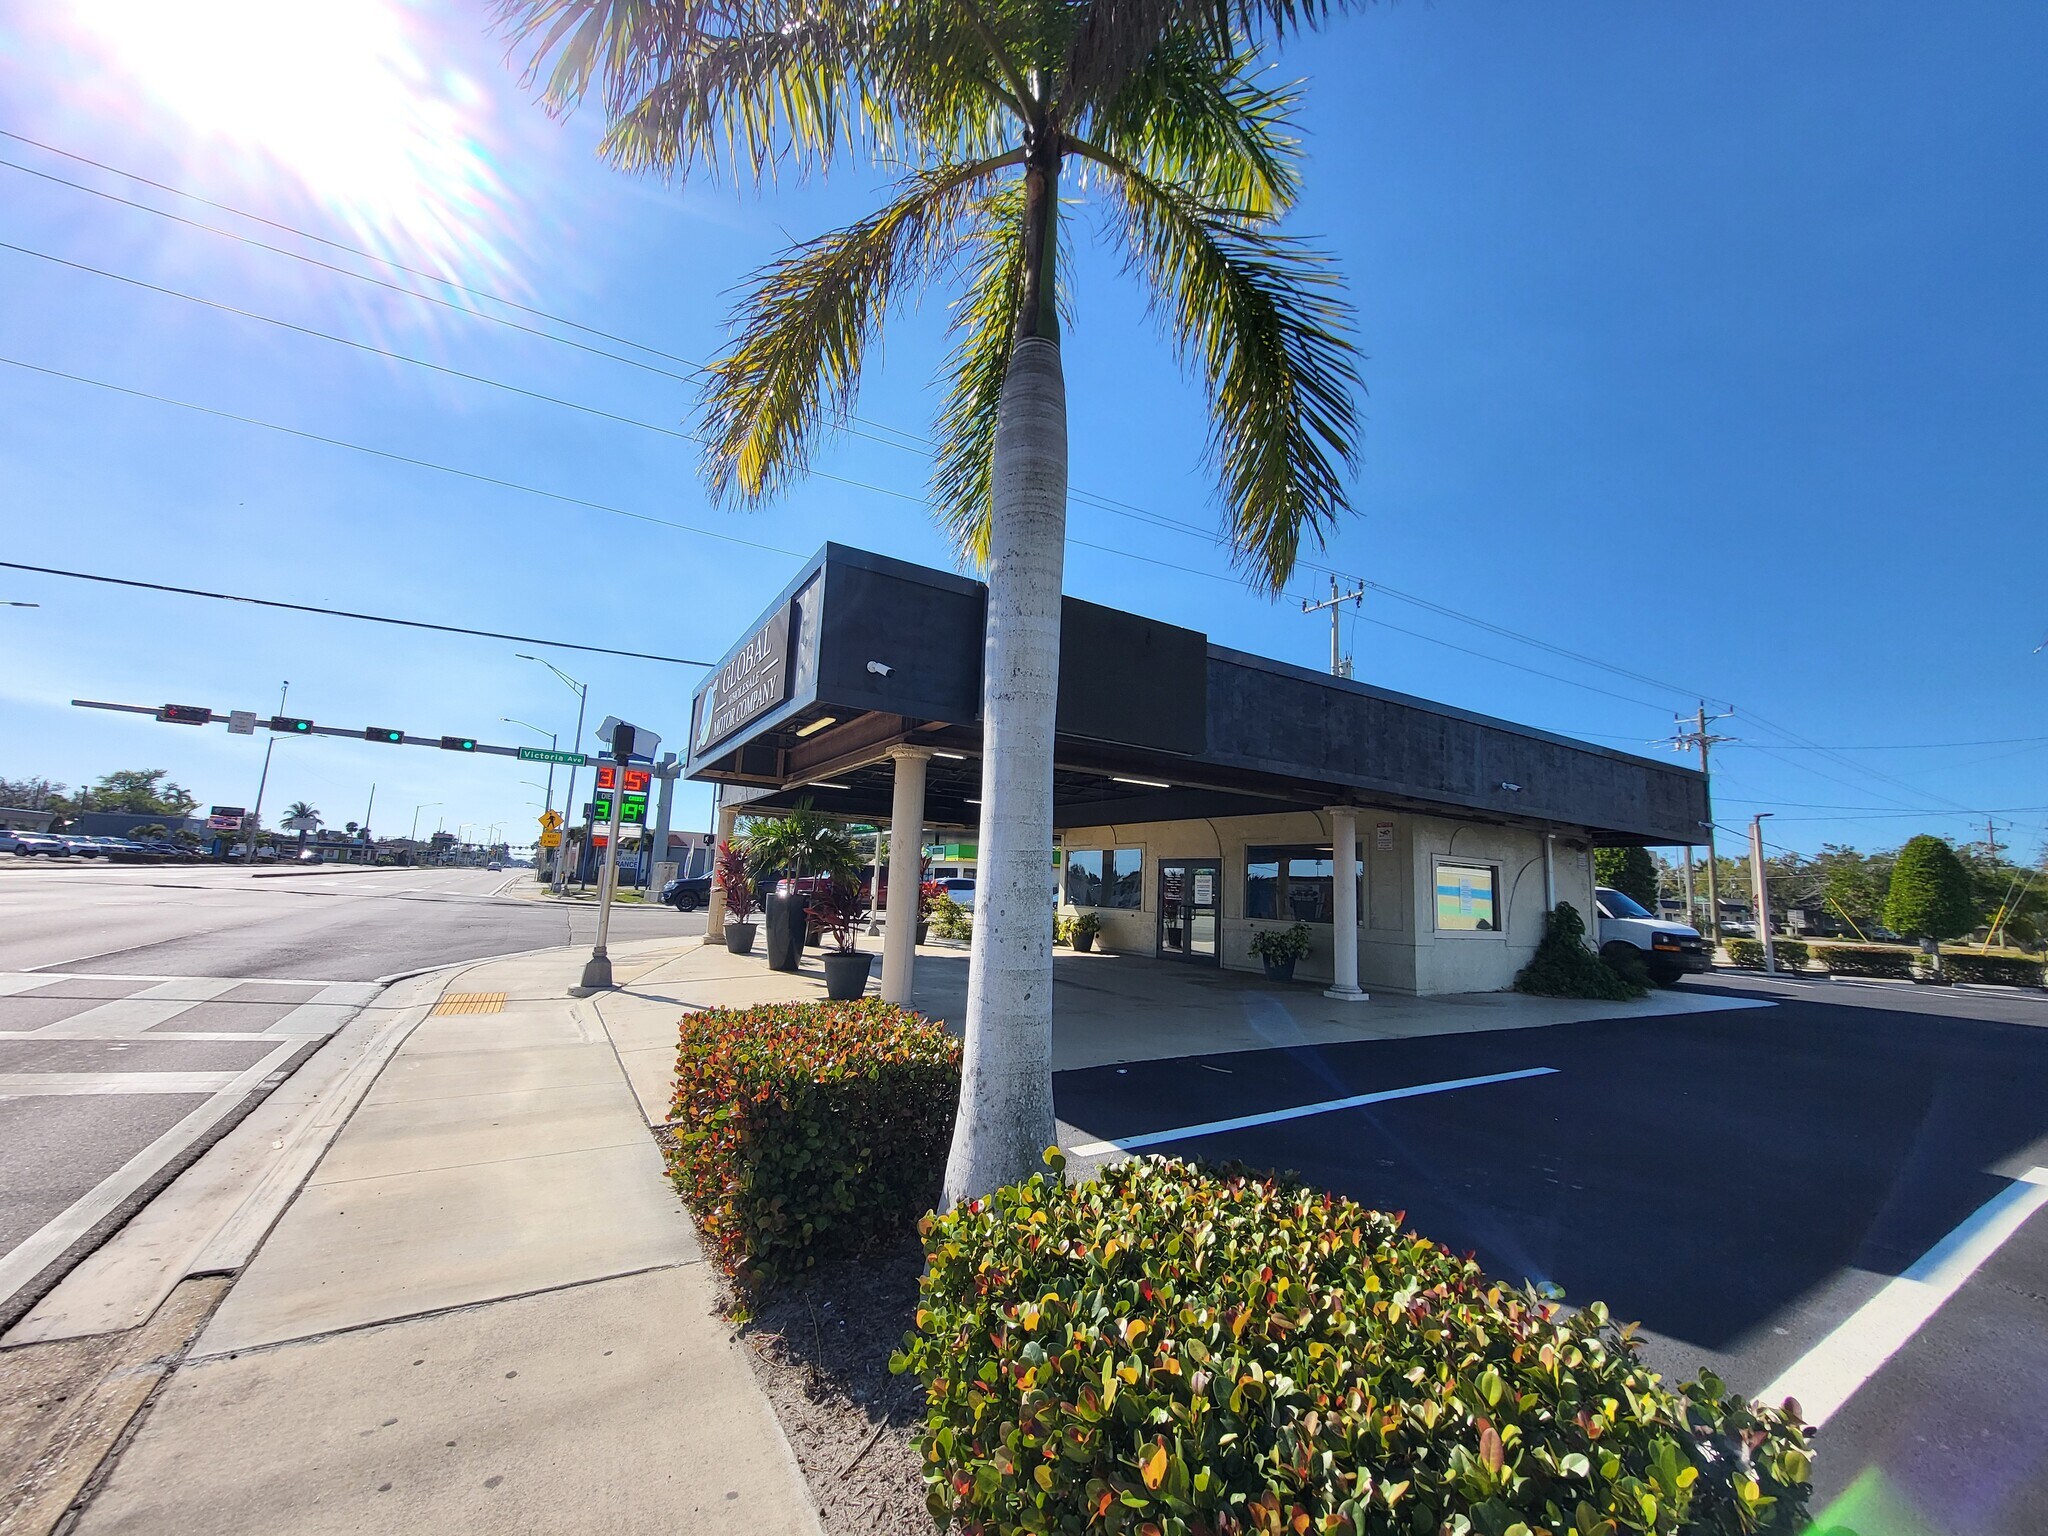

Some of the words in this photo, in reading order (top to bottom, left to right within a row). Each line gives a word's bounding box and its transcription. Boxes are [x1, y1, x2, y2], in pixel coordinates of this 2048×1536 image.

[722, 625, 772, 694] GLOBAL
[712, 707, 735, 739] MOTOR
[736, 674, 778, 722] COMPANY
[727, 670, 761, 706] WHOLESALE
[524, 750, 564, 762] Victoria
